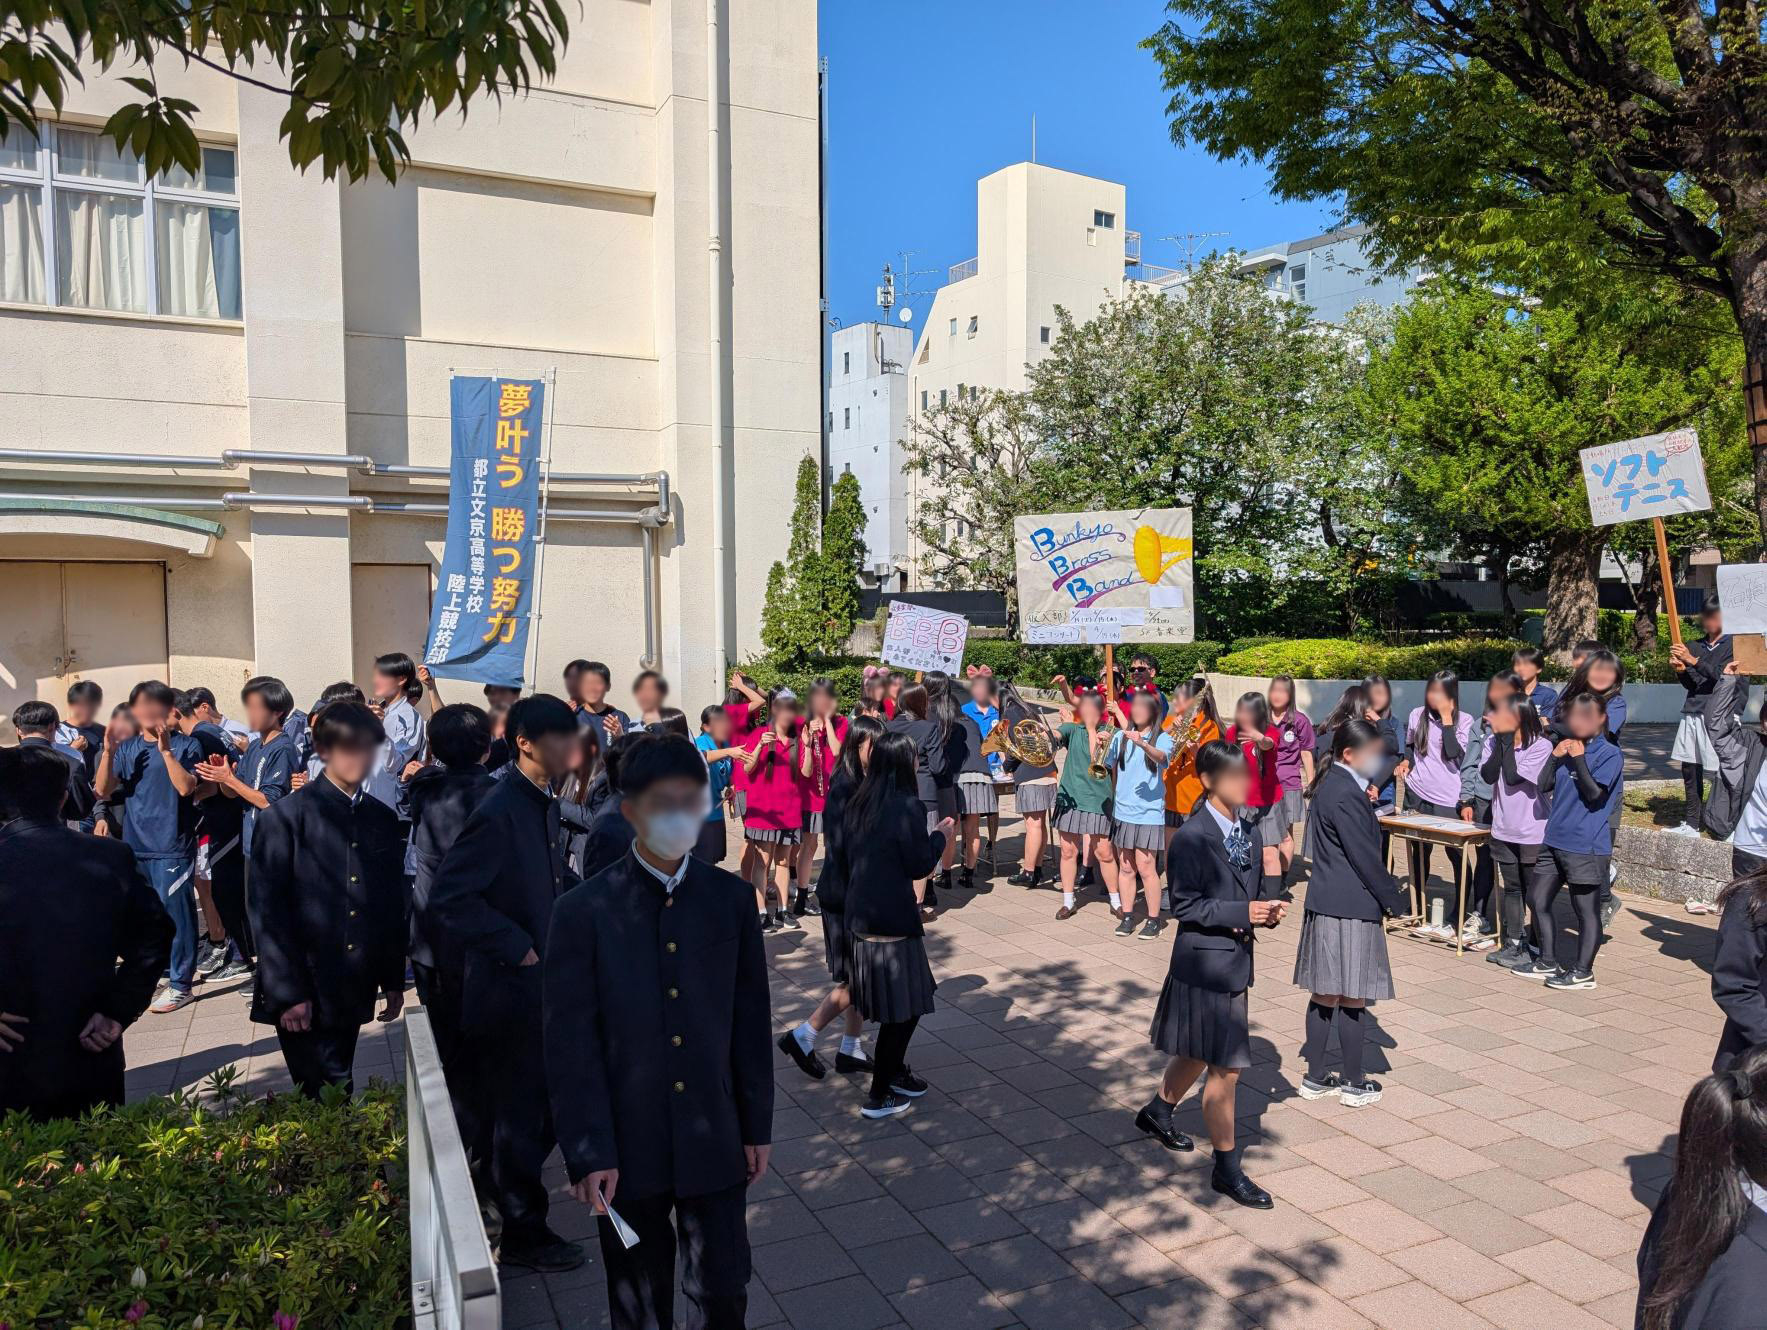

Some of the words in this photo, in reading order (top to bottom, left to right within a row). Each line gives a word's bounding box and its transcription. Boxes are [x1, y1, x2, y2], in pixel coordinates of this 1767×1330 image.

[494, 384, 532, 488] 夢叶う
[1591, 450, 1667, 487] ソフト
[1612, 478, 1689, 512] テニス
[465, 459, 489, 614] 都立文京高等学校
[1030, 520, 1114, 557] Bunkyo
[483, 507, 526, 644] 勝つ努力
[1048, 548, 1112, 578] Brass
[1066, 571, 1134, 602] Band
[428, 573, 466, 665] 陸上競技部
[889, 614, 966, 654] BBB
